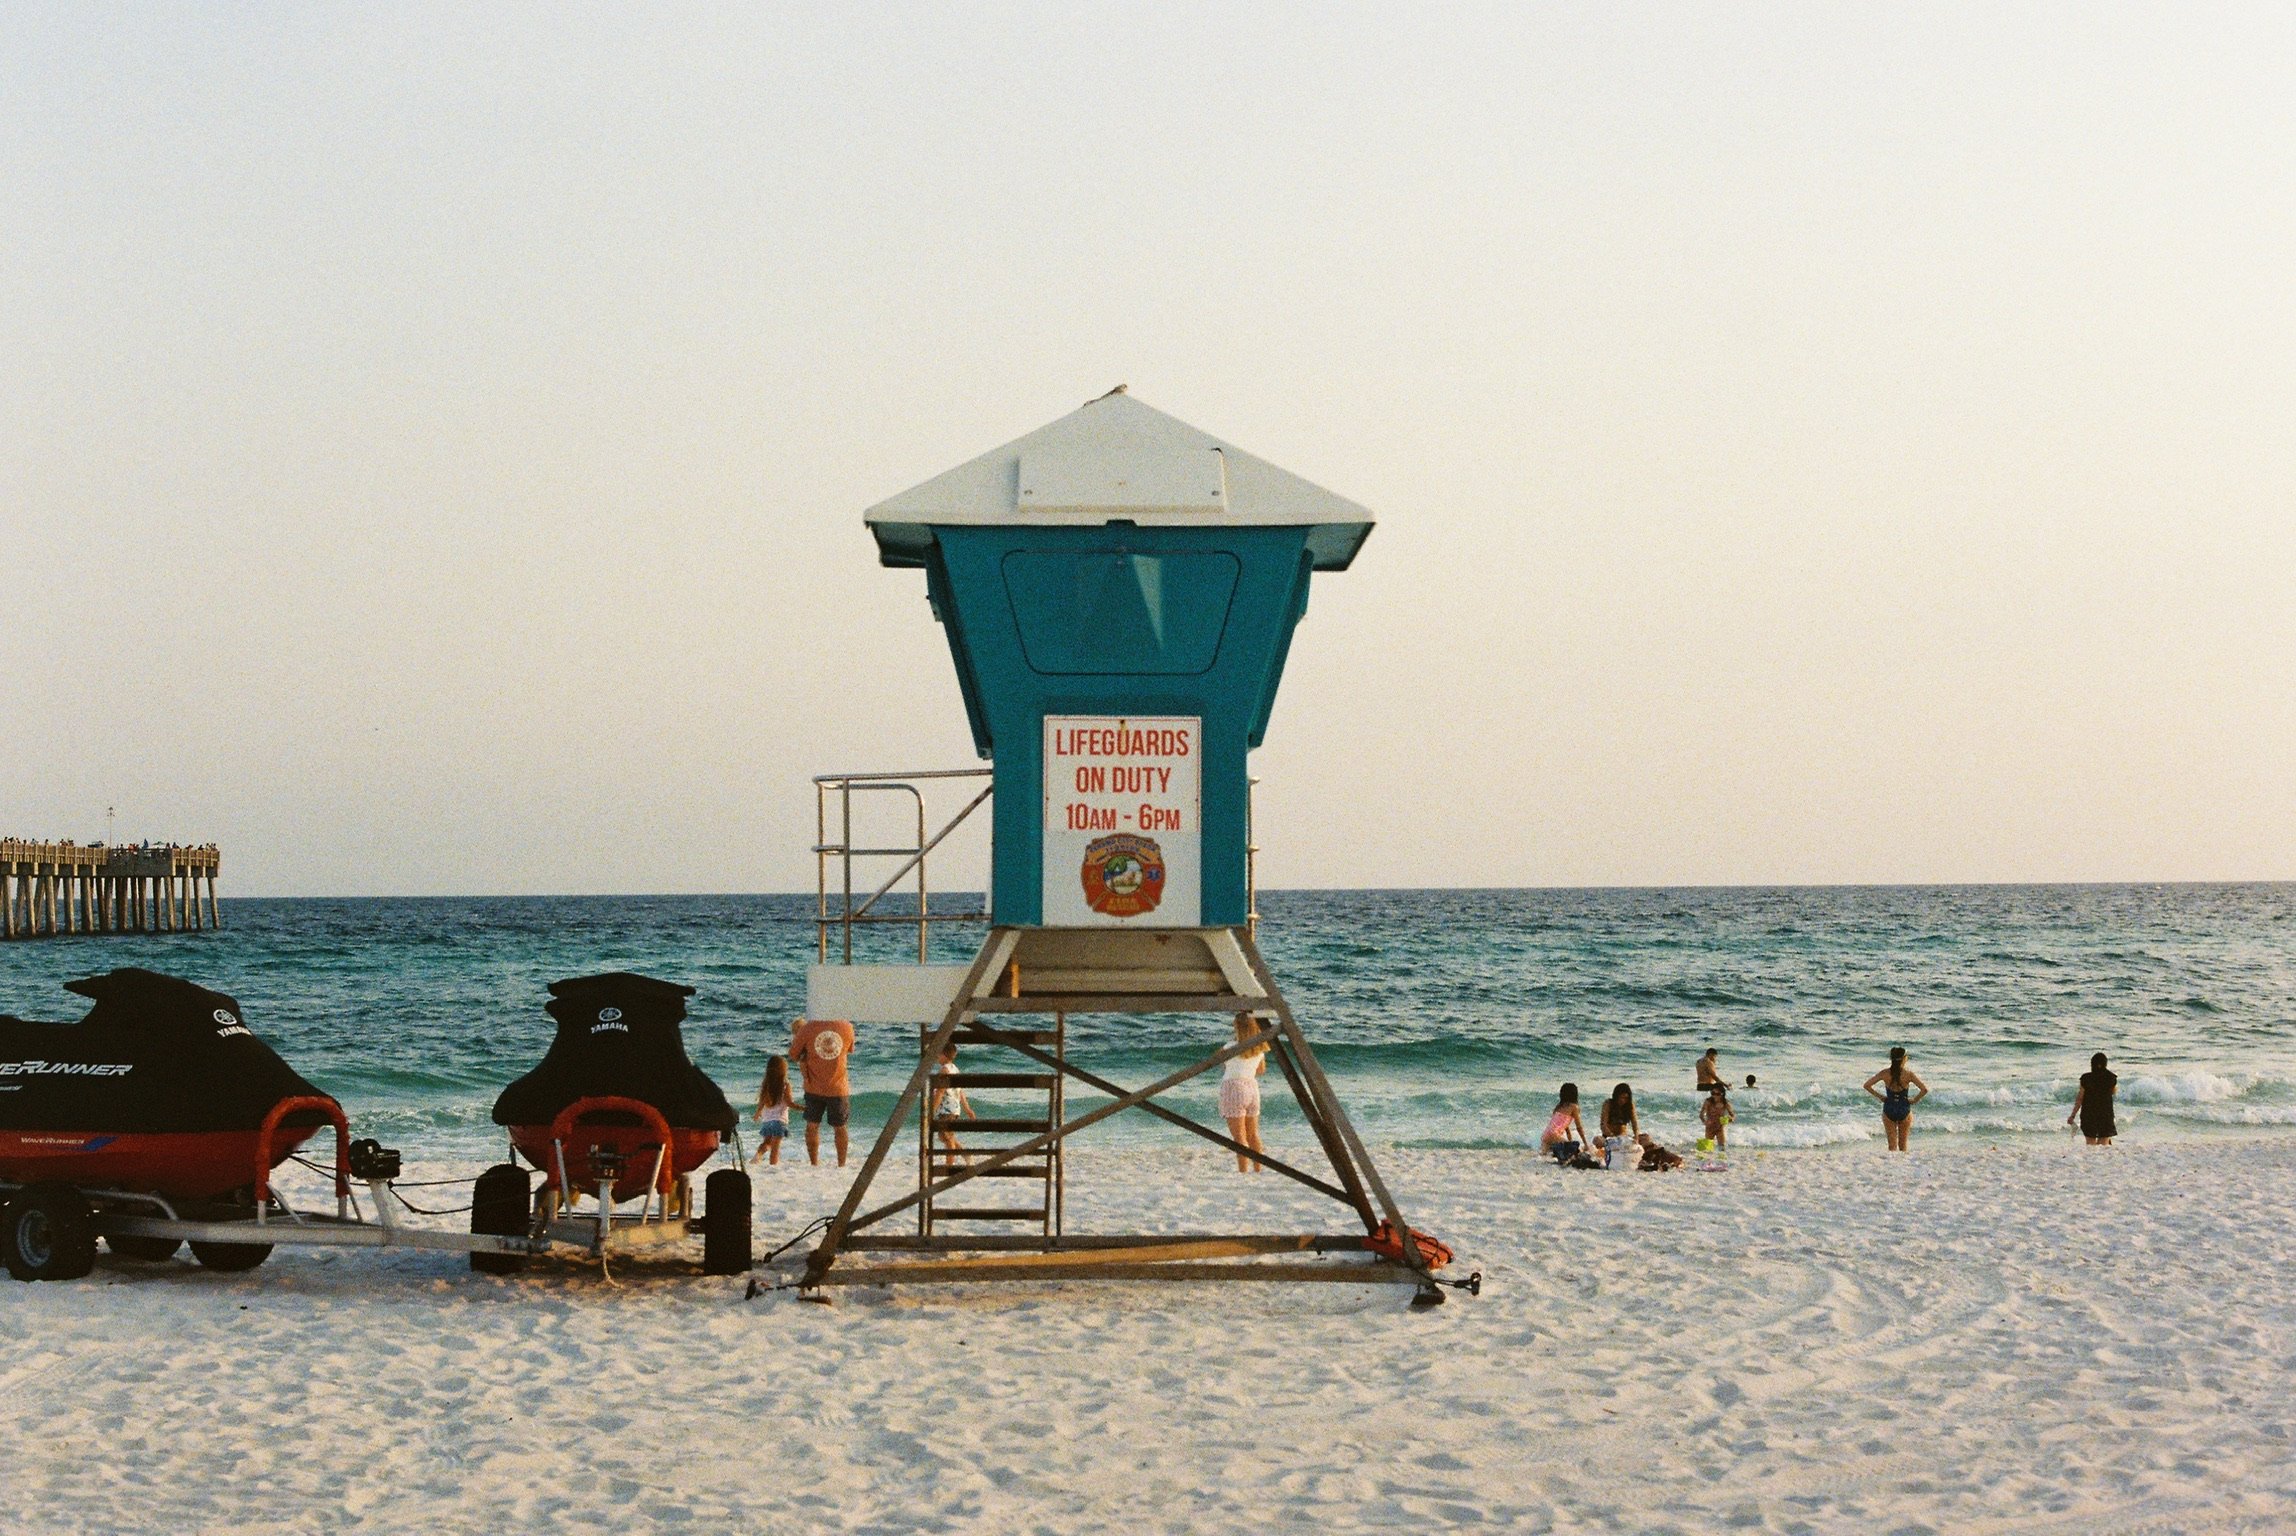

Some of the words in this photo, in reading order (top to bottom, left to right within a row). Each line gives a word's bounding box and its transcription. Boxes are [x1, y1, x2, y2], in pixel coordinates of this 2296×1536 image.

[1056, 729, 1189, 756] LIFEGUARDS
[1076, 766, 1105, 793] ON
[1112, 766, 1171, 793] DUTY
[1065, 803, 1117, 830] 10AM
[1139, 803, 1180, 831] 6PM
[590, 1022, 629, 1034] YAMAHA
